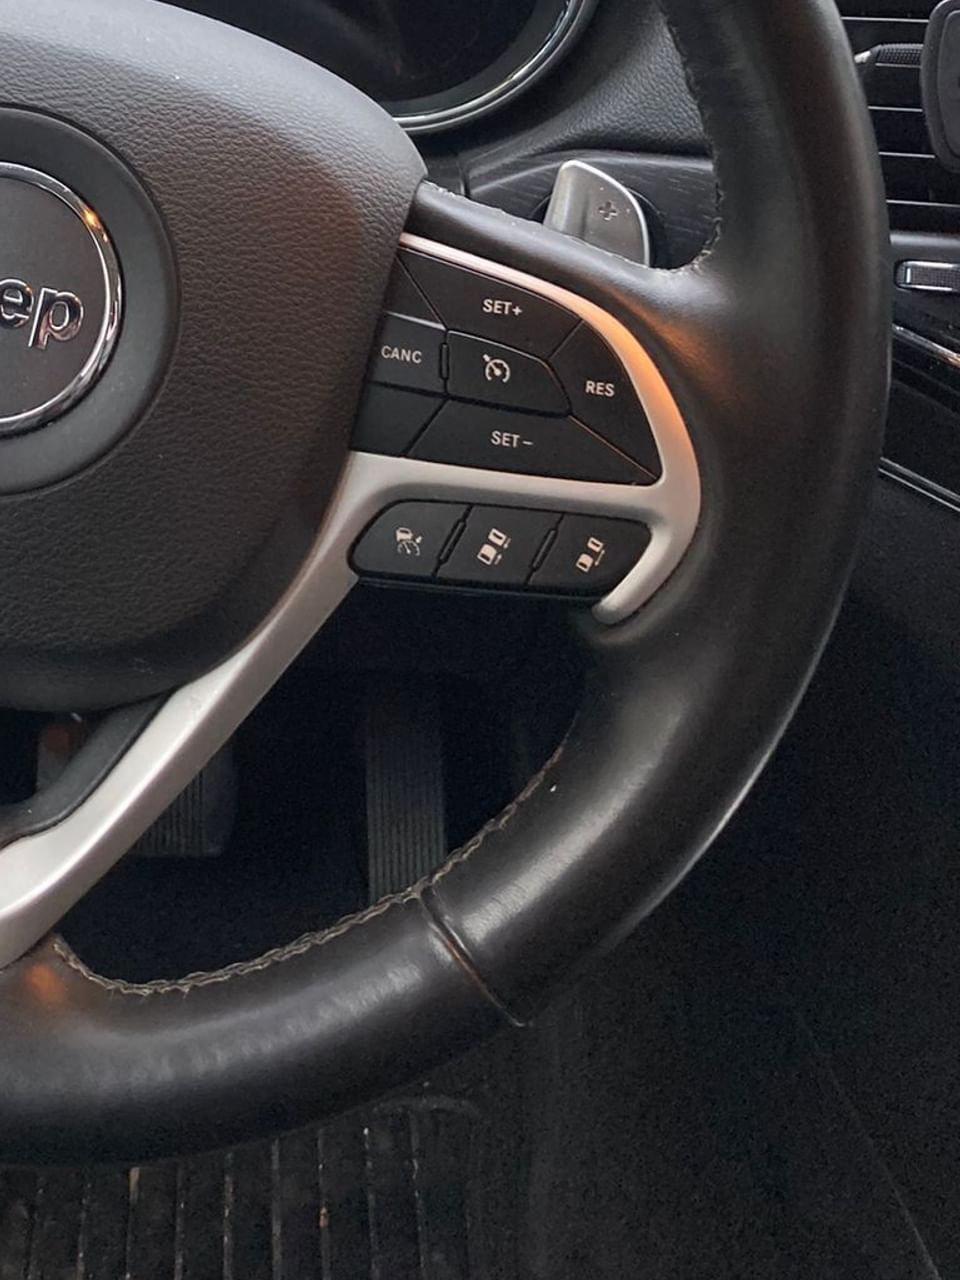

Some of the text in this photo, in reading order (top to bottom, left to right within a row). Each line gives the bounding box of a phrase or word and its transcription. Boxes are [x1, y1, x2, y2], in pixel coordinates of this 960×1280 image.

[482, 298, 523, 316] SET+
[381, 345, 422, 364] CANC
[585, 380, 615, 397] RES
